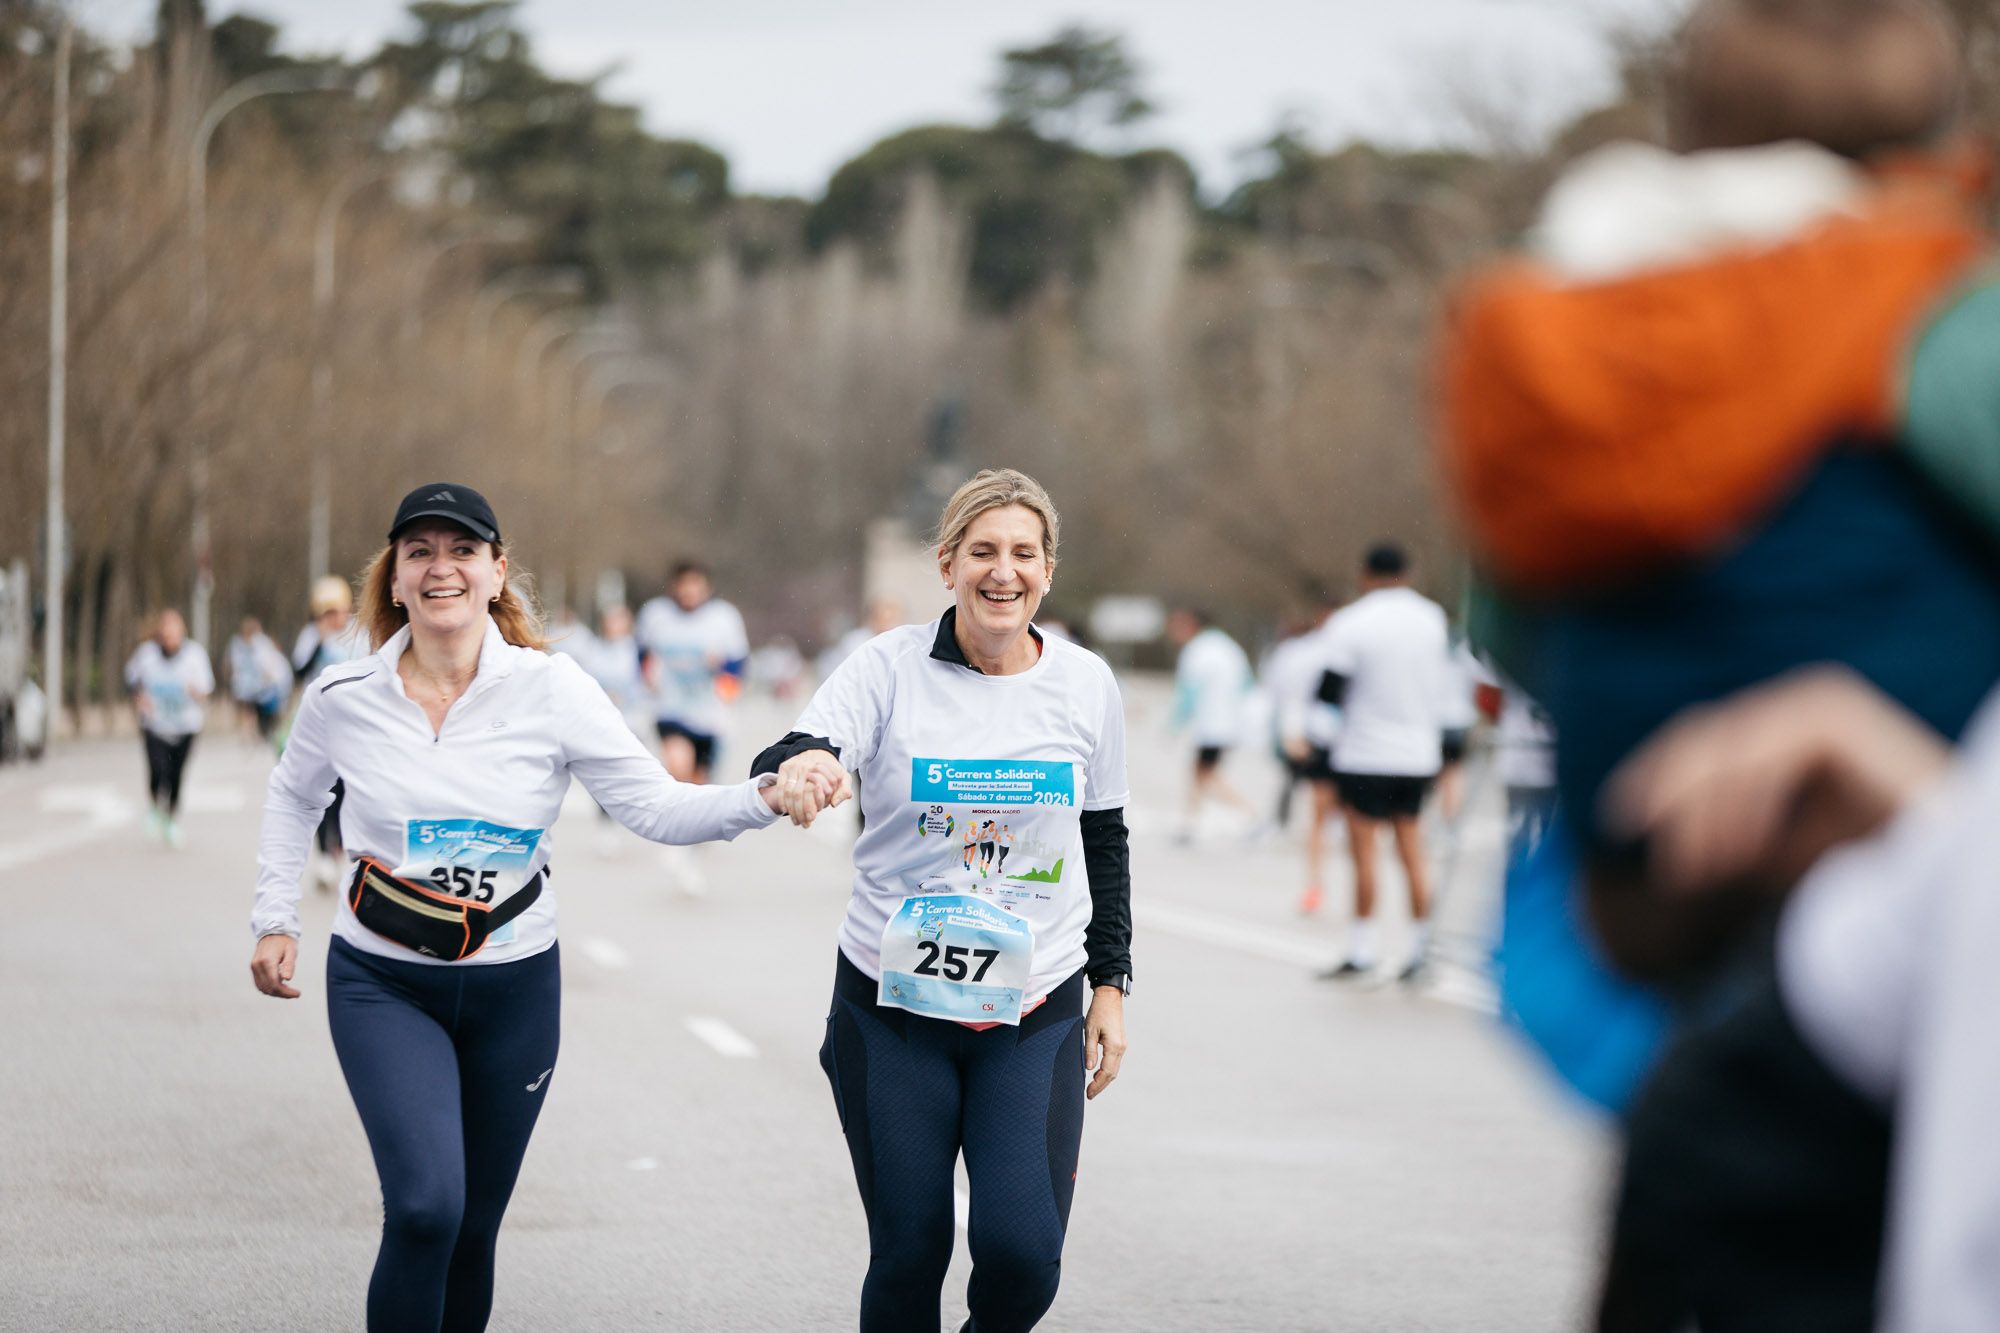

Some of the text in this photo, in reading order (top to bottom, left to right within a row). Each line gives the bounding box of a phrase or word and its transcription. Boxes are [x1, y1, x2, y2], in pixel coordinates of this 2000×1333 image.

[945, 768, 992, 779] Carrera
[994, 769, 1046, 780] Solidaria
[957, 793, 987, 801] Sábado
[996, 793, 1006, 801] de
[1033, 791, 1070, 806] 2026
[930, 805, 943, 814] 20
[926, 904, 963, 914] Carrera
[913, 940, 1001, 982] 257
